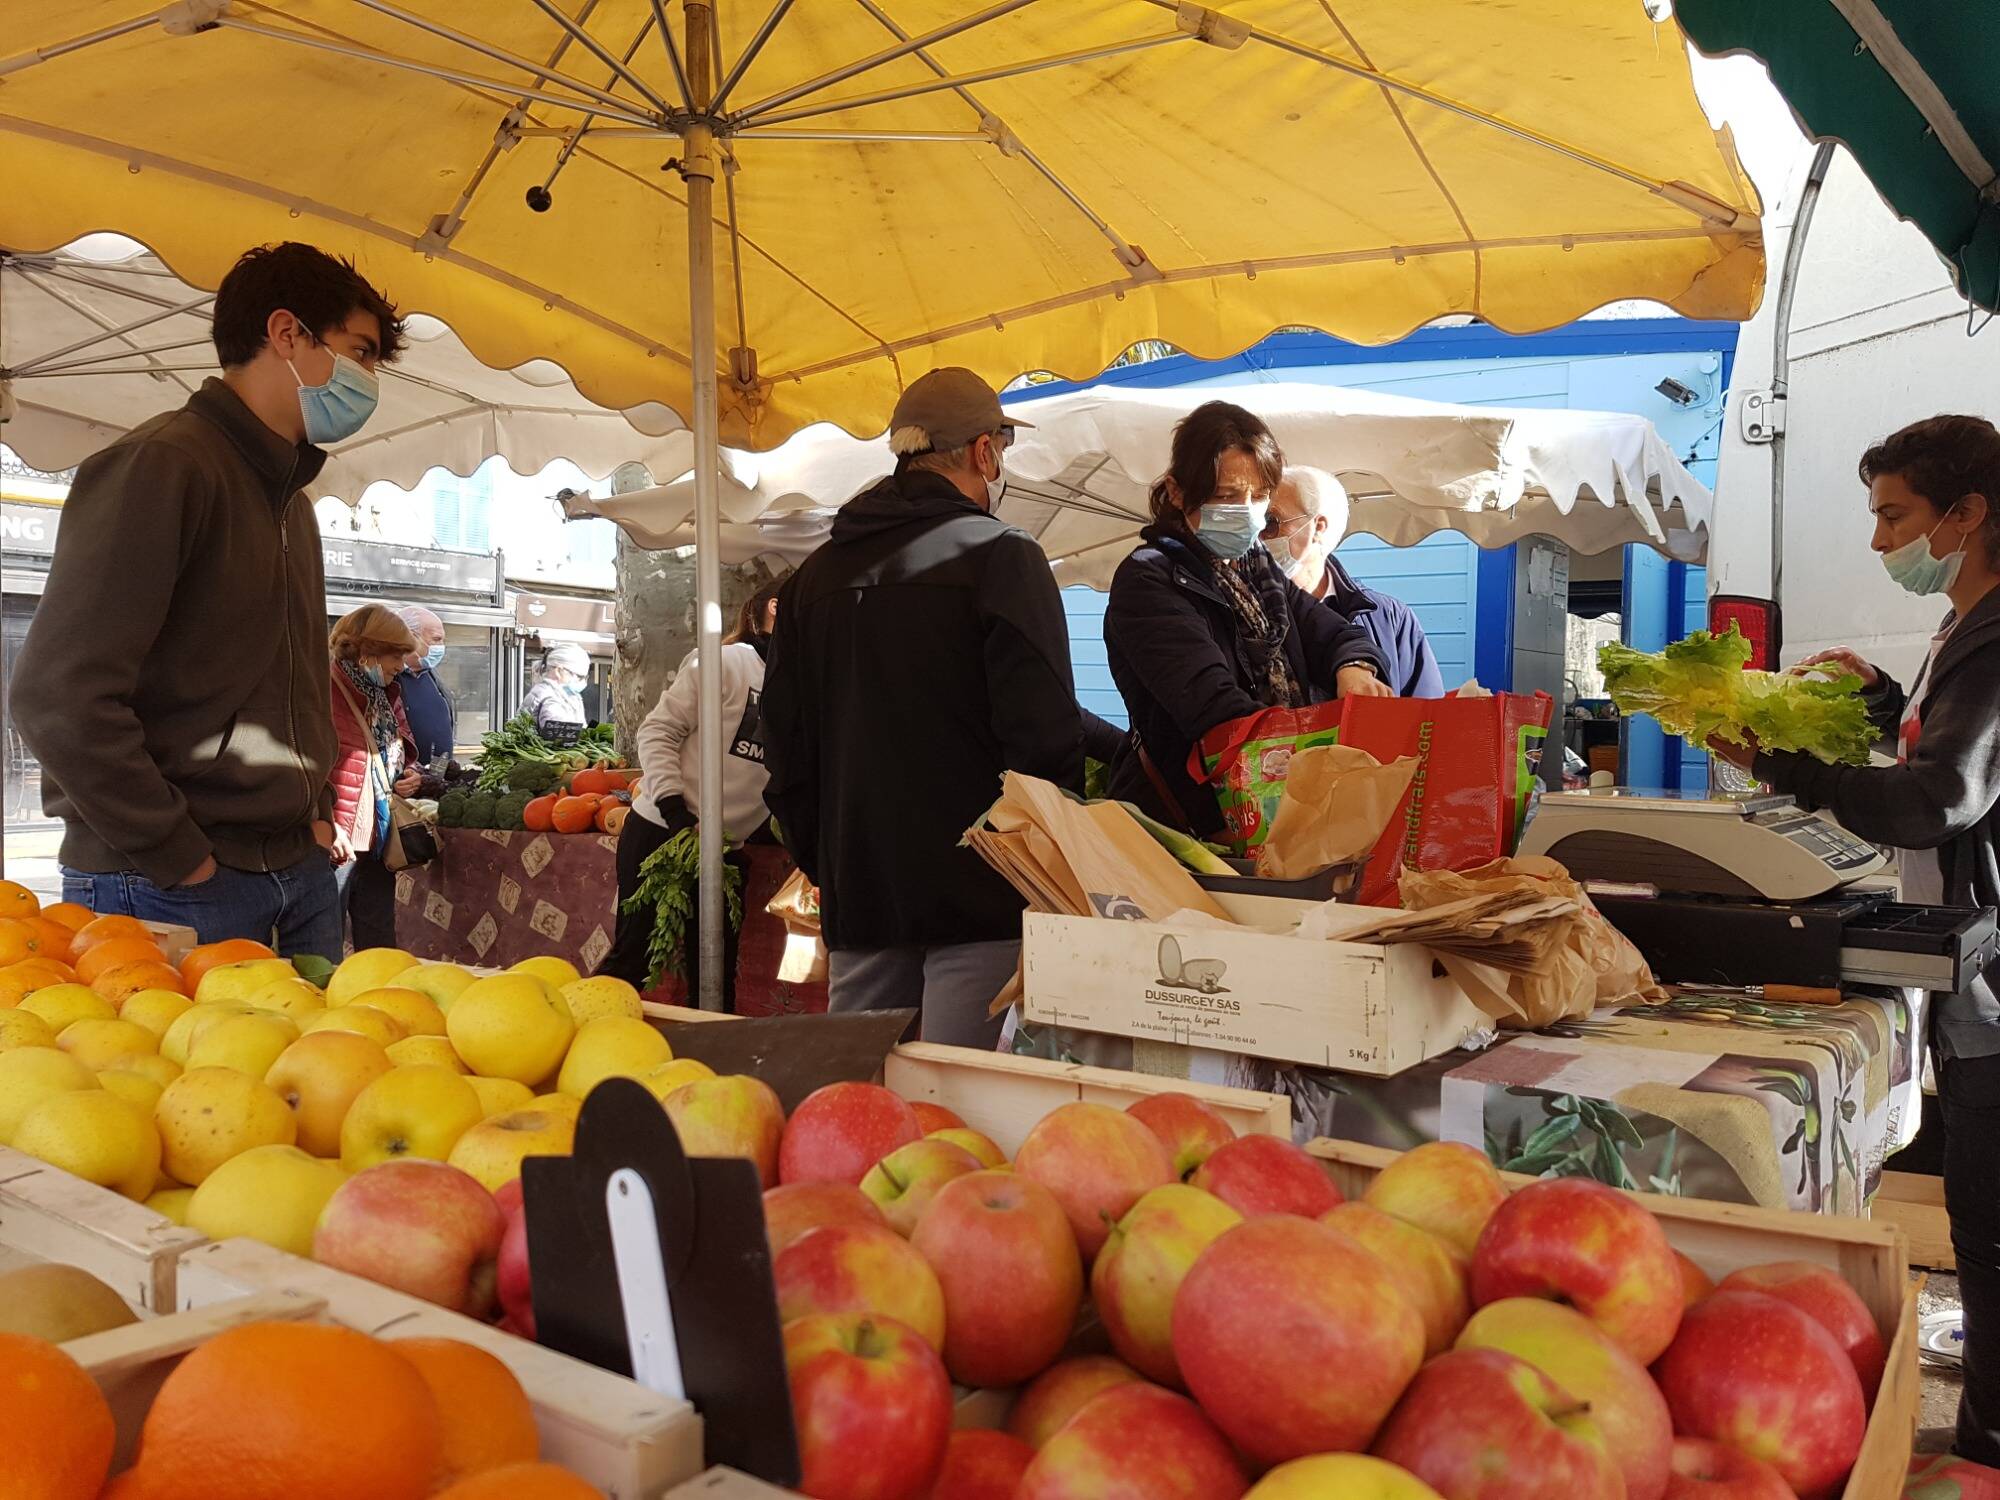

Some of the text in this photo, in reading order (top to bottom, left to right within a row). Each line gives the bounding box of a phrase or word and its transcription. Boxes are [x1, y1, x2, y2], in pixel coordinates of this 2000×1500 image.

[1145, 990, 1214, 1007] DUSSURGEY
[1217, 1000, 1240, 1011] SAS
[1349, 1049, 1369, 1062] 5 Kg
